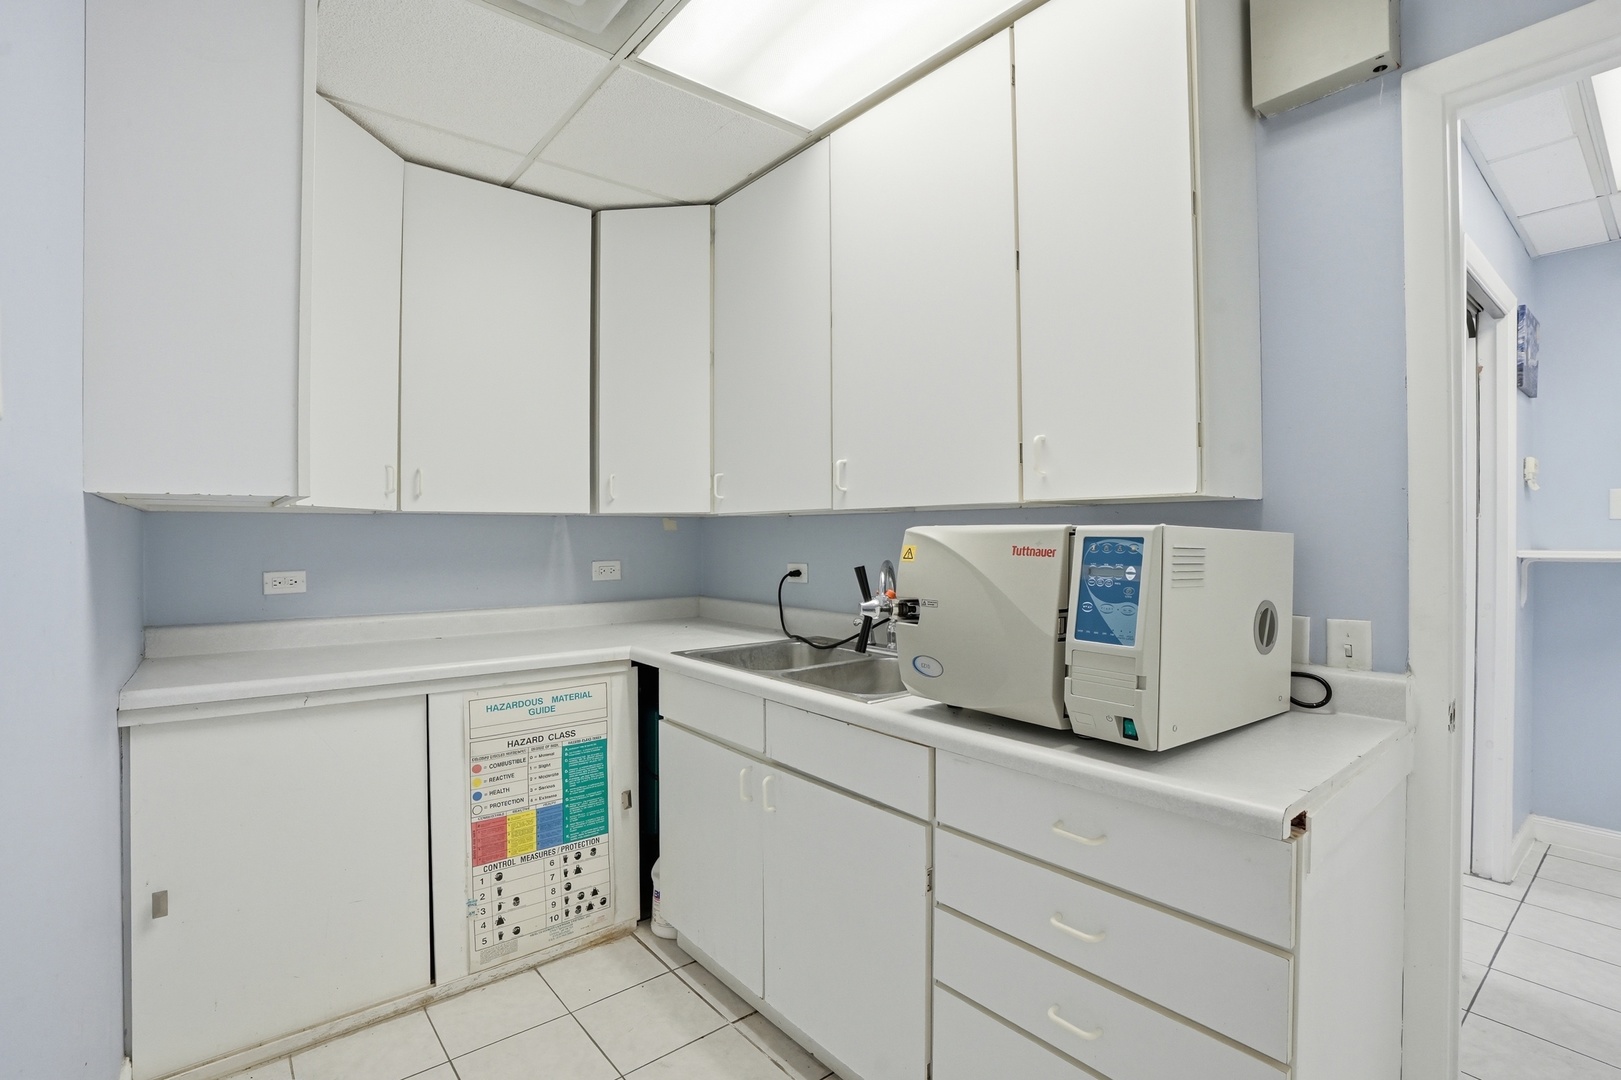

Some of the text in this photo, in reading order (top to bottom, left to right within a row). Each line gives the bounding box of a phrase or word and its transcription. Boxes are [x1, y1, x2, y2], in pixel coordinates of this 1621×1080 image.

[1012, 546, 1056, 558] Tuttnauer
[486, 691, 592, 712] HAZARDOUS MATERIAL
[528, 705, 556, 716] GUIDE
[508, 730, 576, 748] HAZARD CLASS
[489, 758, 526, 770] COMBUSTIBLE
[489, 773, 514, 783] REACTIVE
[489, 787, 510, 796] HEALTH
[490, 798, 524, 808] PROTECTION
[483, 859, 516, 872] CONTROL
[549, 914, 559, 922] 10
